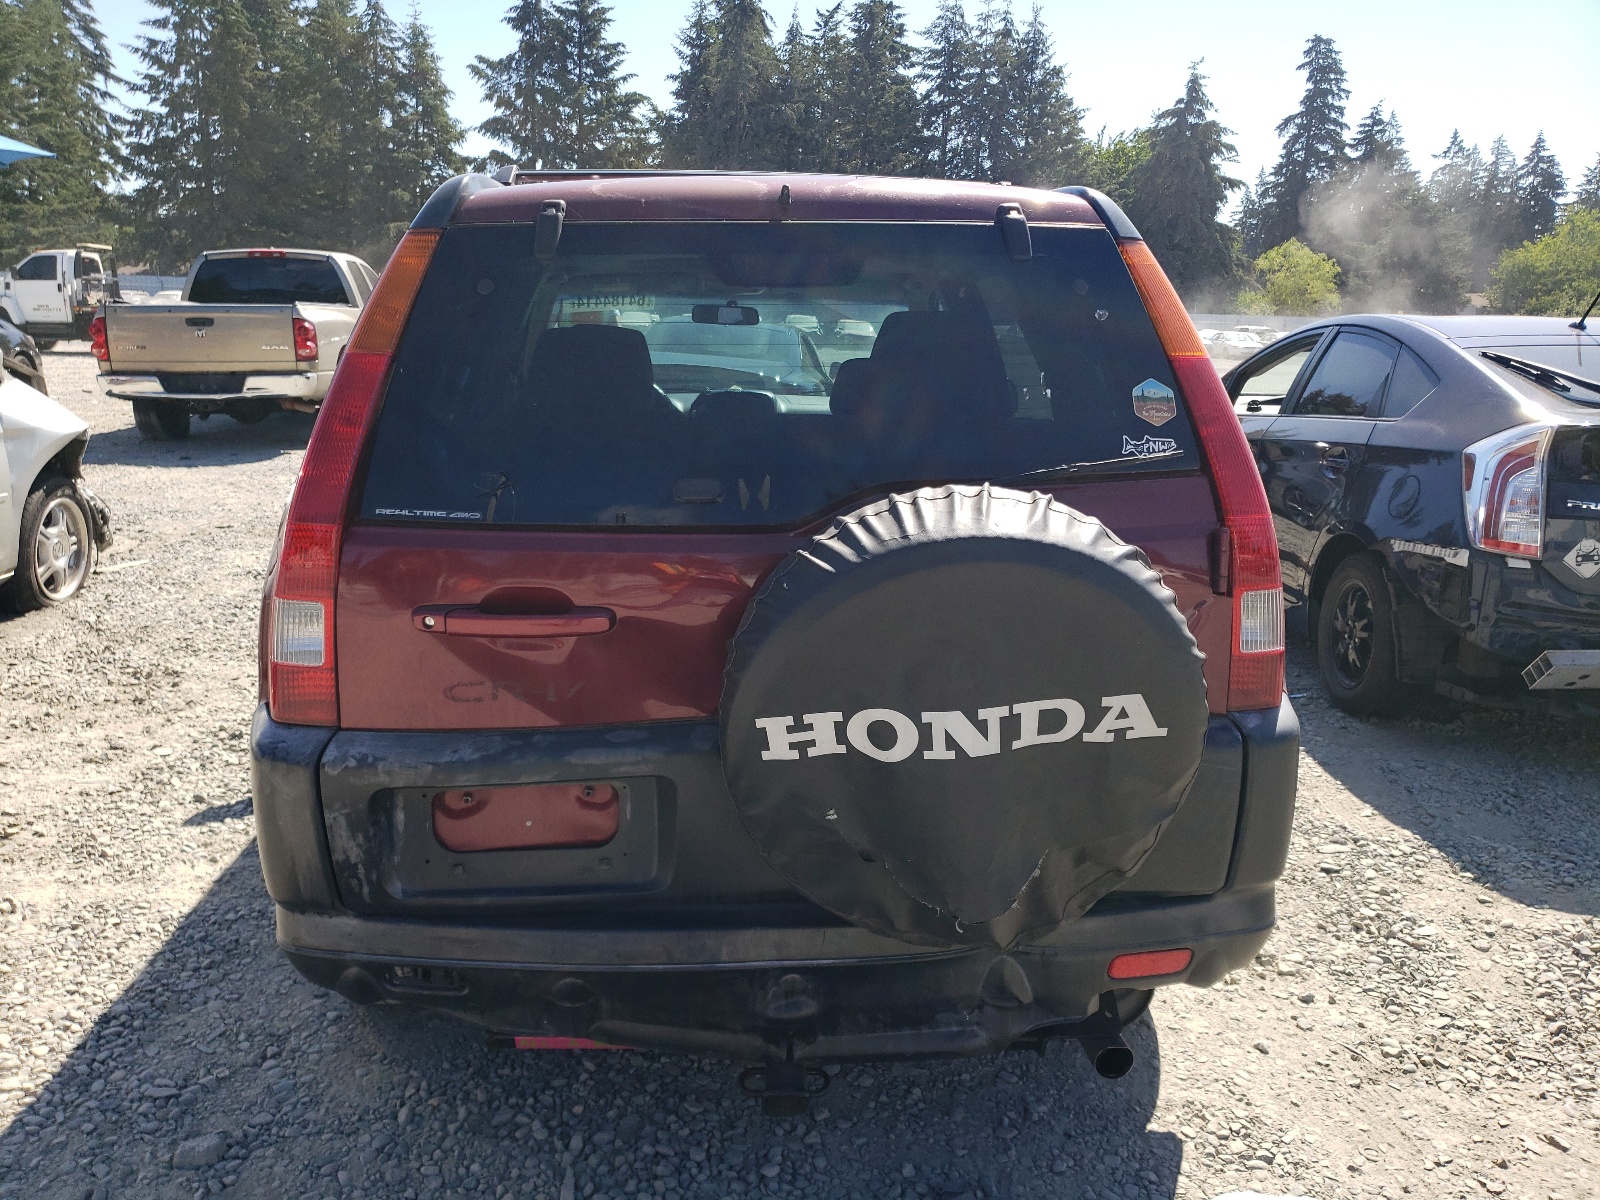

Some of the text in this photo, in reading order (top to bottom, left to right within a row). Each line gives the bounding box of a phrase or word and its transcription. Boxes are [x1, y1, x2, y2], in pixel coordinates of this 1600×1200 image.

[1143, 441, 1167, 453] PNW
[375, 508, 447, 517] REALTIME
[755, 693, 1168, 763] HONDA
